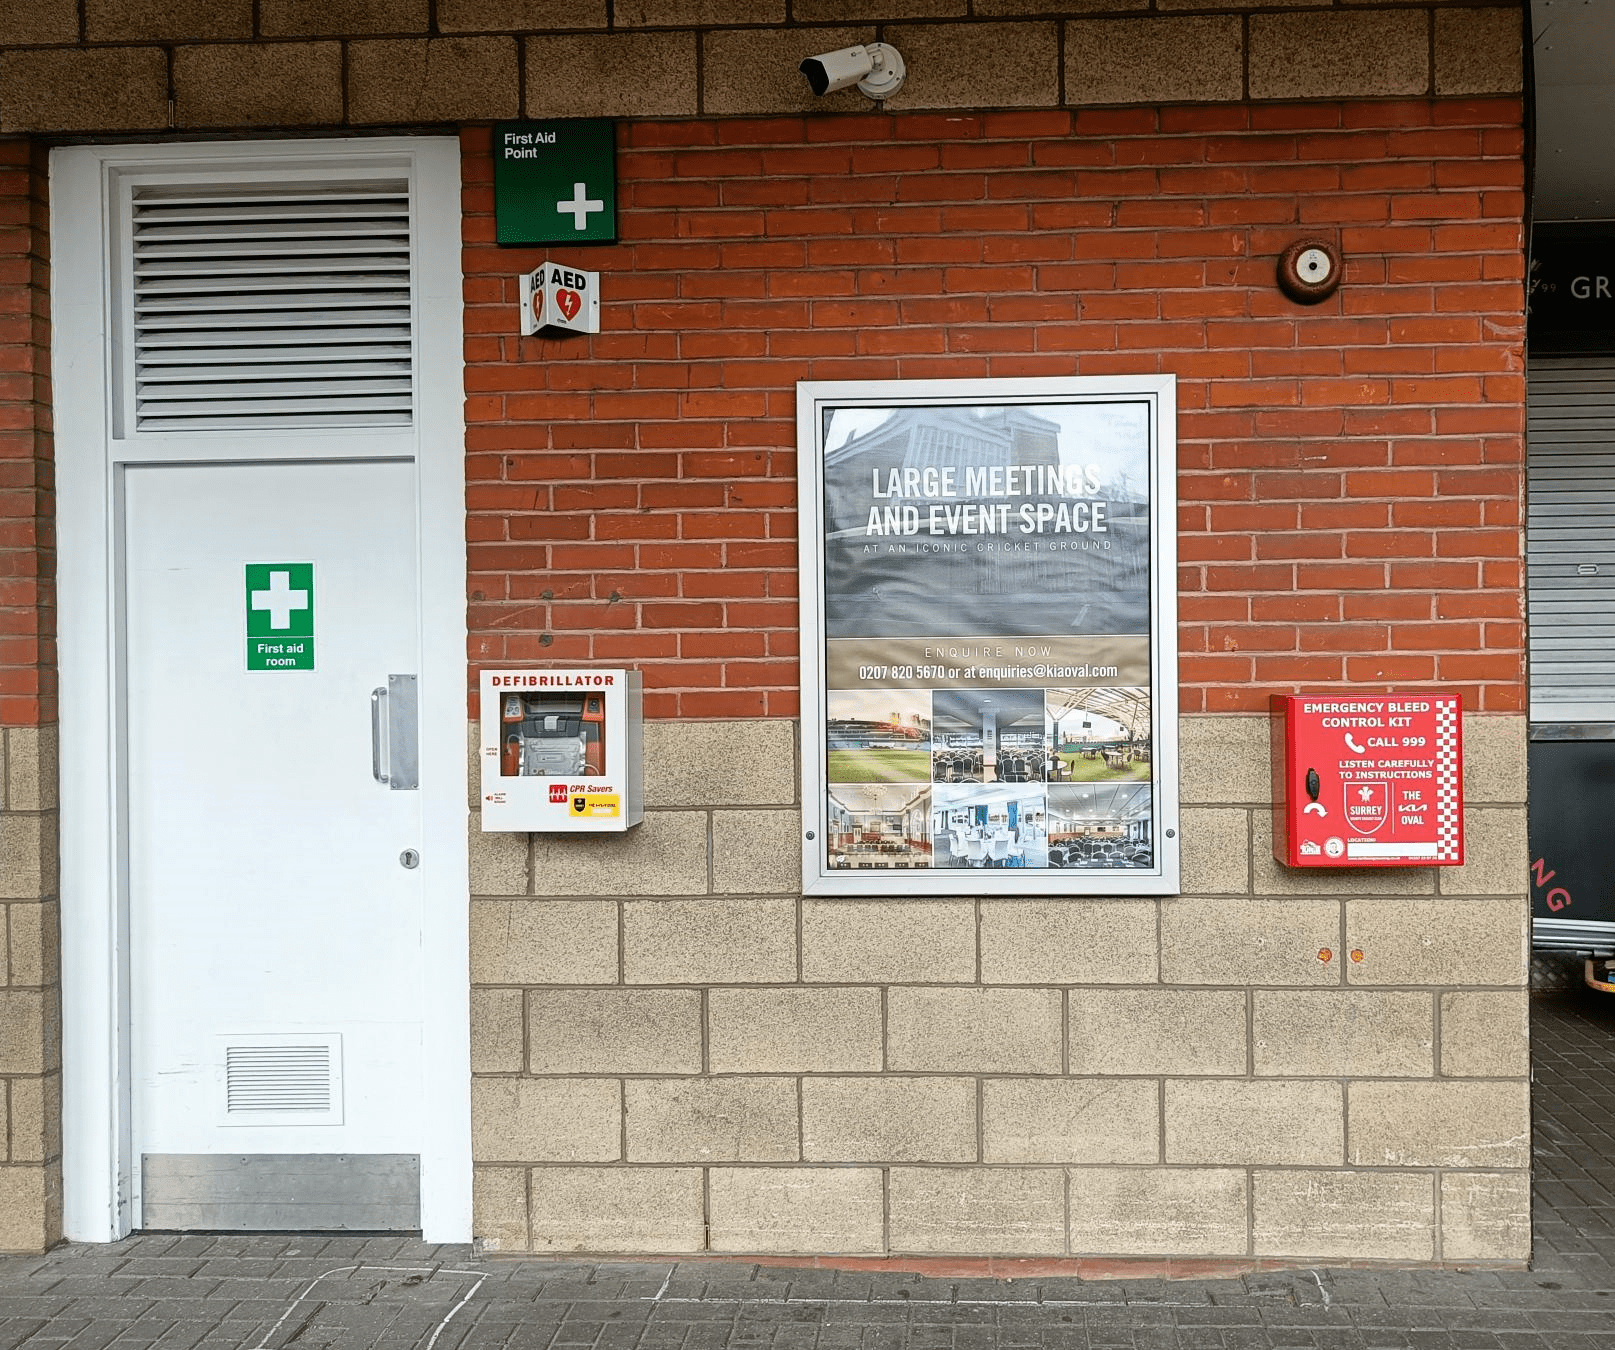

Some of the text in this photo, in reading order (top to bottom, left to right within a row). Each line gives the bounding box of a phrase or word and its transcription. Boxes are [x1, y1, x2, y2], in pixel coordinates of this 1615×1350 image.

[504, 131, 556, 145] First Aid
[504, 147, 538, 159] Point
[530, 268, 545, 294] AED
[551, 268, 587, 291] AED
[1570, 275, 1613, 299] GR
[872, 463, 1101, 498] LARGE MEETINGS
[866, 502, 1108, 536] AND EVENT SPACE
[863, 540, 1112, 554] AT AN ICONIC CRICKET GROUND
[257, 643, 304, 654] First aid
[924, 645, 1053, 658] ENQUIRE NOW
[266, 658, 296, 666] room
[859, 663, 1118, 681] 0207 820 5670 or at enquiries@kiaoval.com
[492, 676, 614, 687] DEFIBRILLATOR
[1303, 702, 1430, 714] EMERGENCY BLEED
[1322, 716, 1412, 728] CONTROL KIT
[1367, 736, 1426, 747] CALL 999
[1339, 759, 1435, 768] LISTEN CAREFULLY
[1339, 770, 1433, 779] TO INSTRUCTIONS
[569, 784, 613, 793] CPR Savers
[1402, 790, 1422, 800] THE
[1349, 805, 1383, 815] SURREY
[1401, 815, 1425, 825] OVAL
